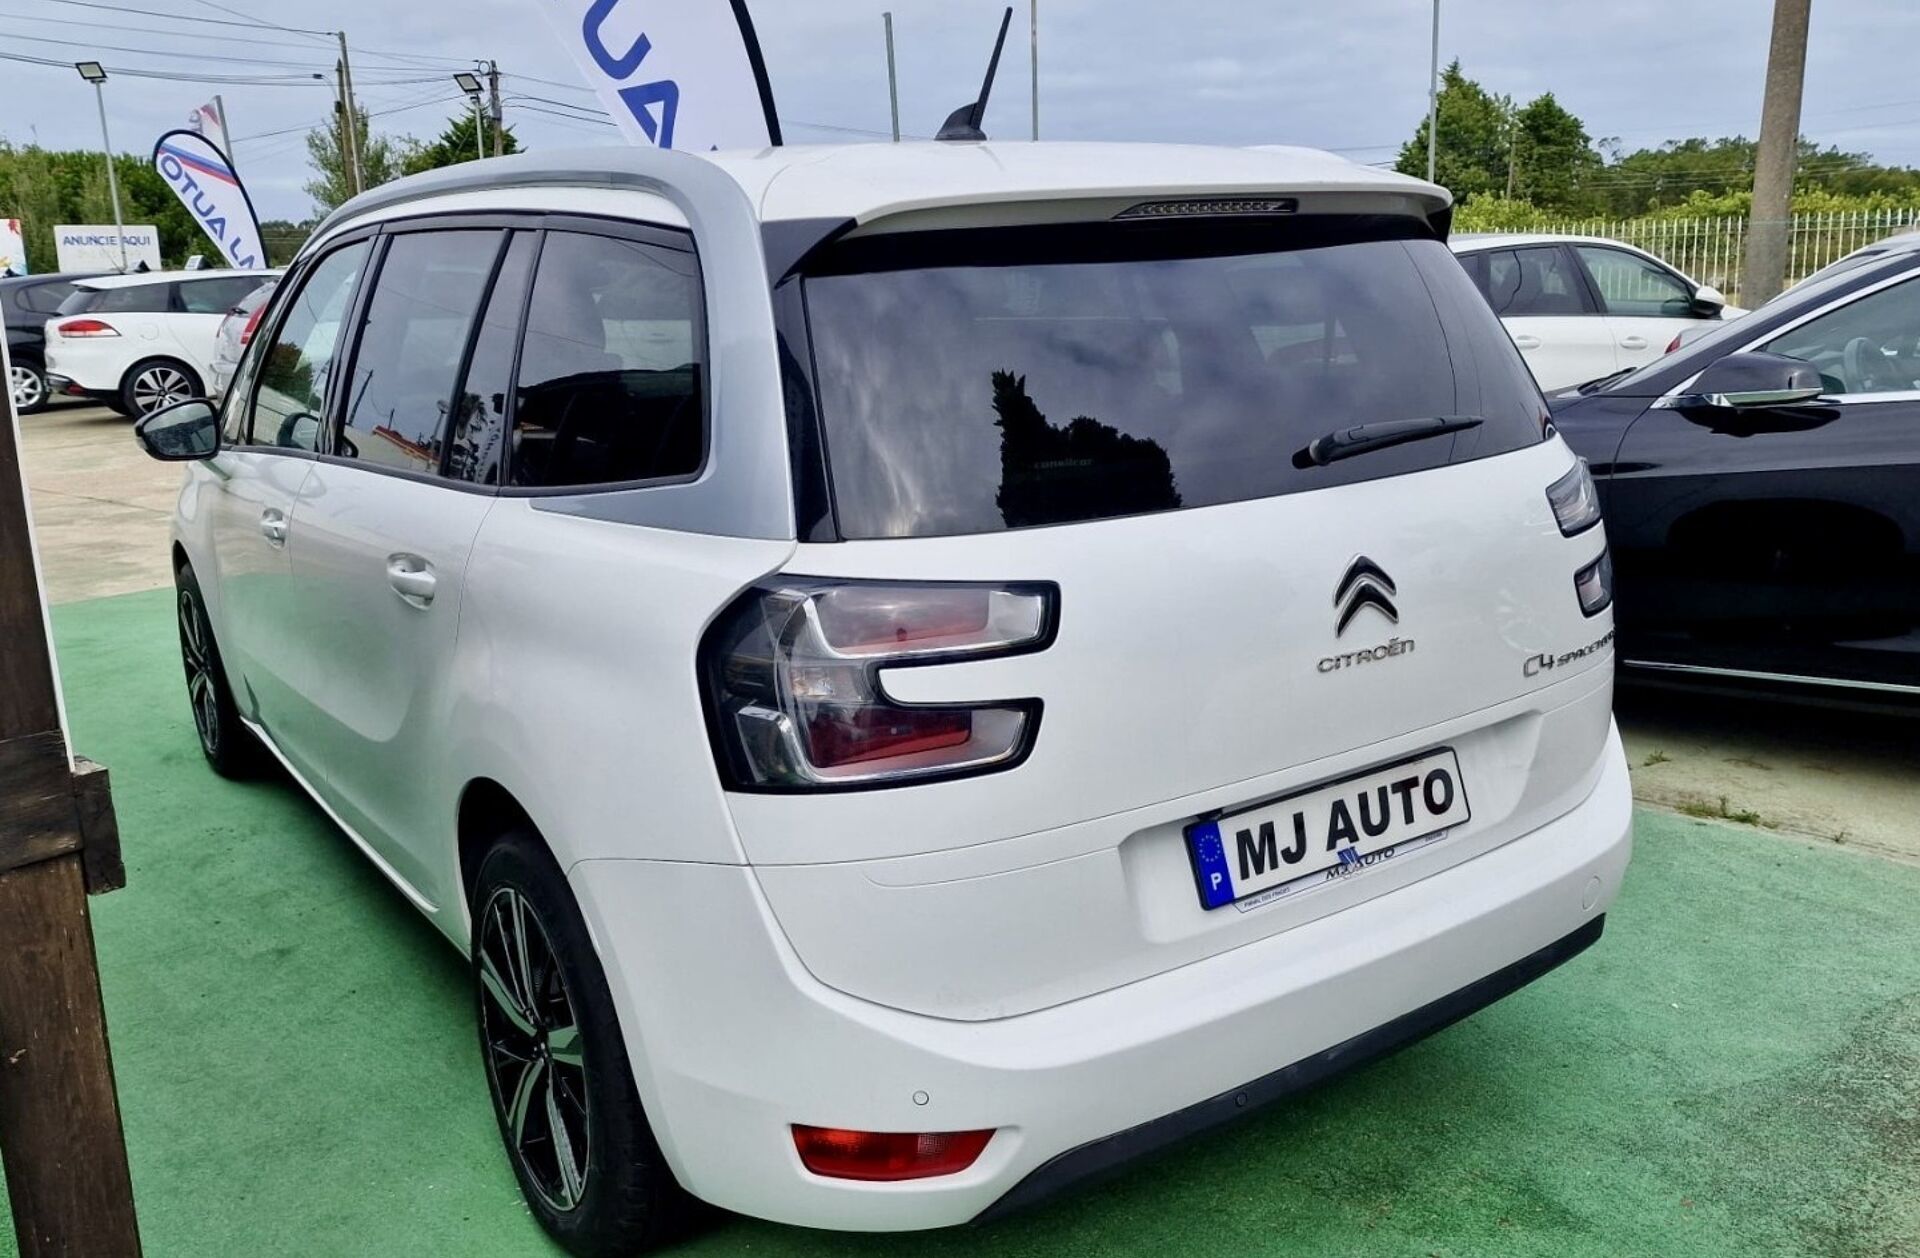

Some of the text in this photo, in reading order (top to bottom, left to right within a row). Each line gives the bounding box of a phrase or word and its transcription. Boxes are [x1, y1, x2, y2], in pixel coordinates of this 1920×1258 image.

[63, 235, 151, 246] ANUNCIE AQUI
[1317, 637, 1415, 673] CITROËN
[1523, 653, 1555, 678] C4
[1235, 768, 1455, 881] MJ AUTO
[1211, 872, 1223, 891] P
